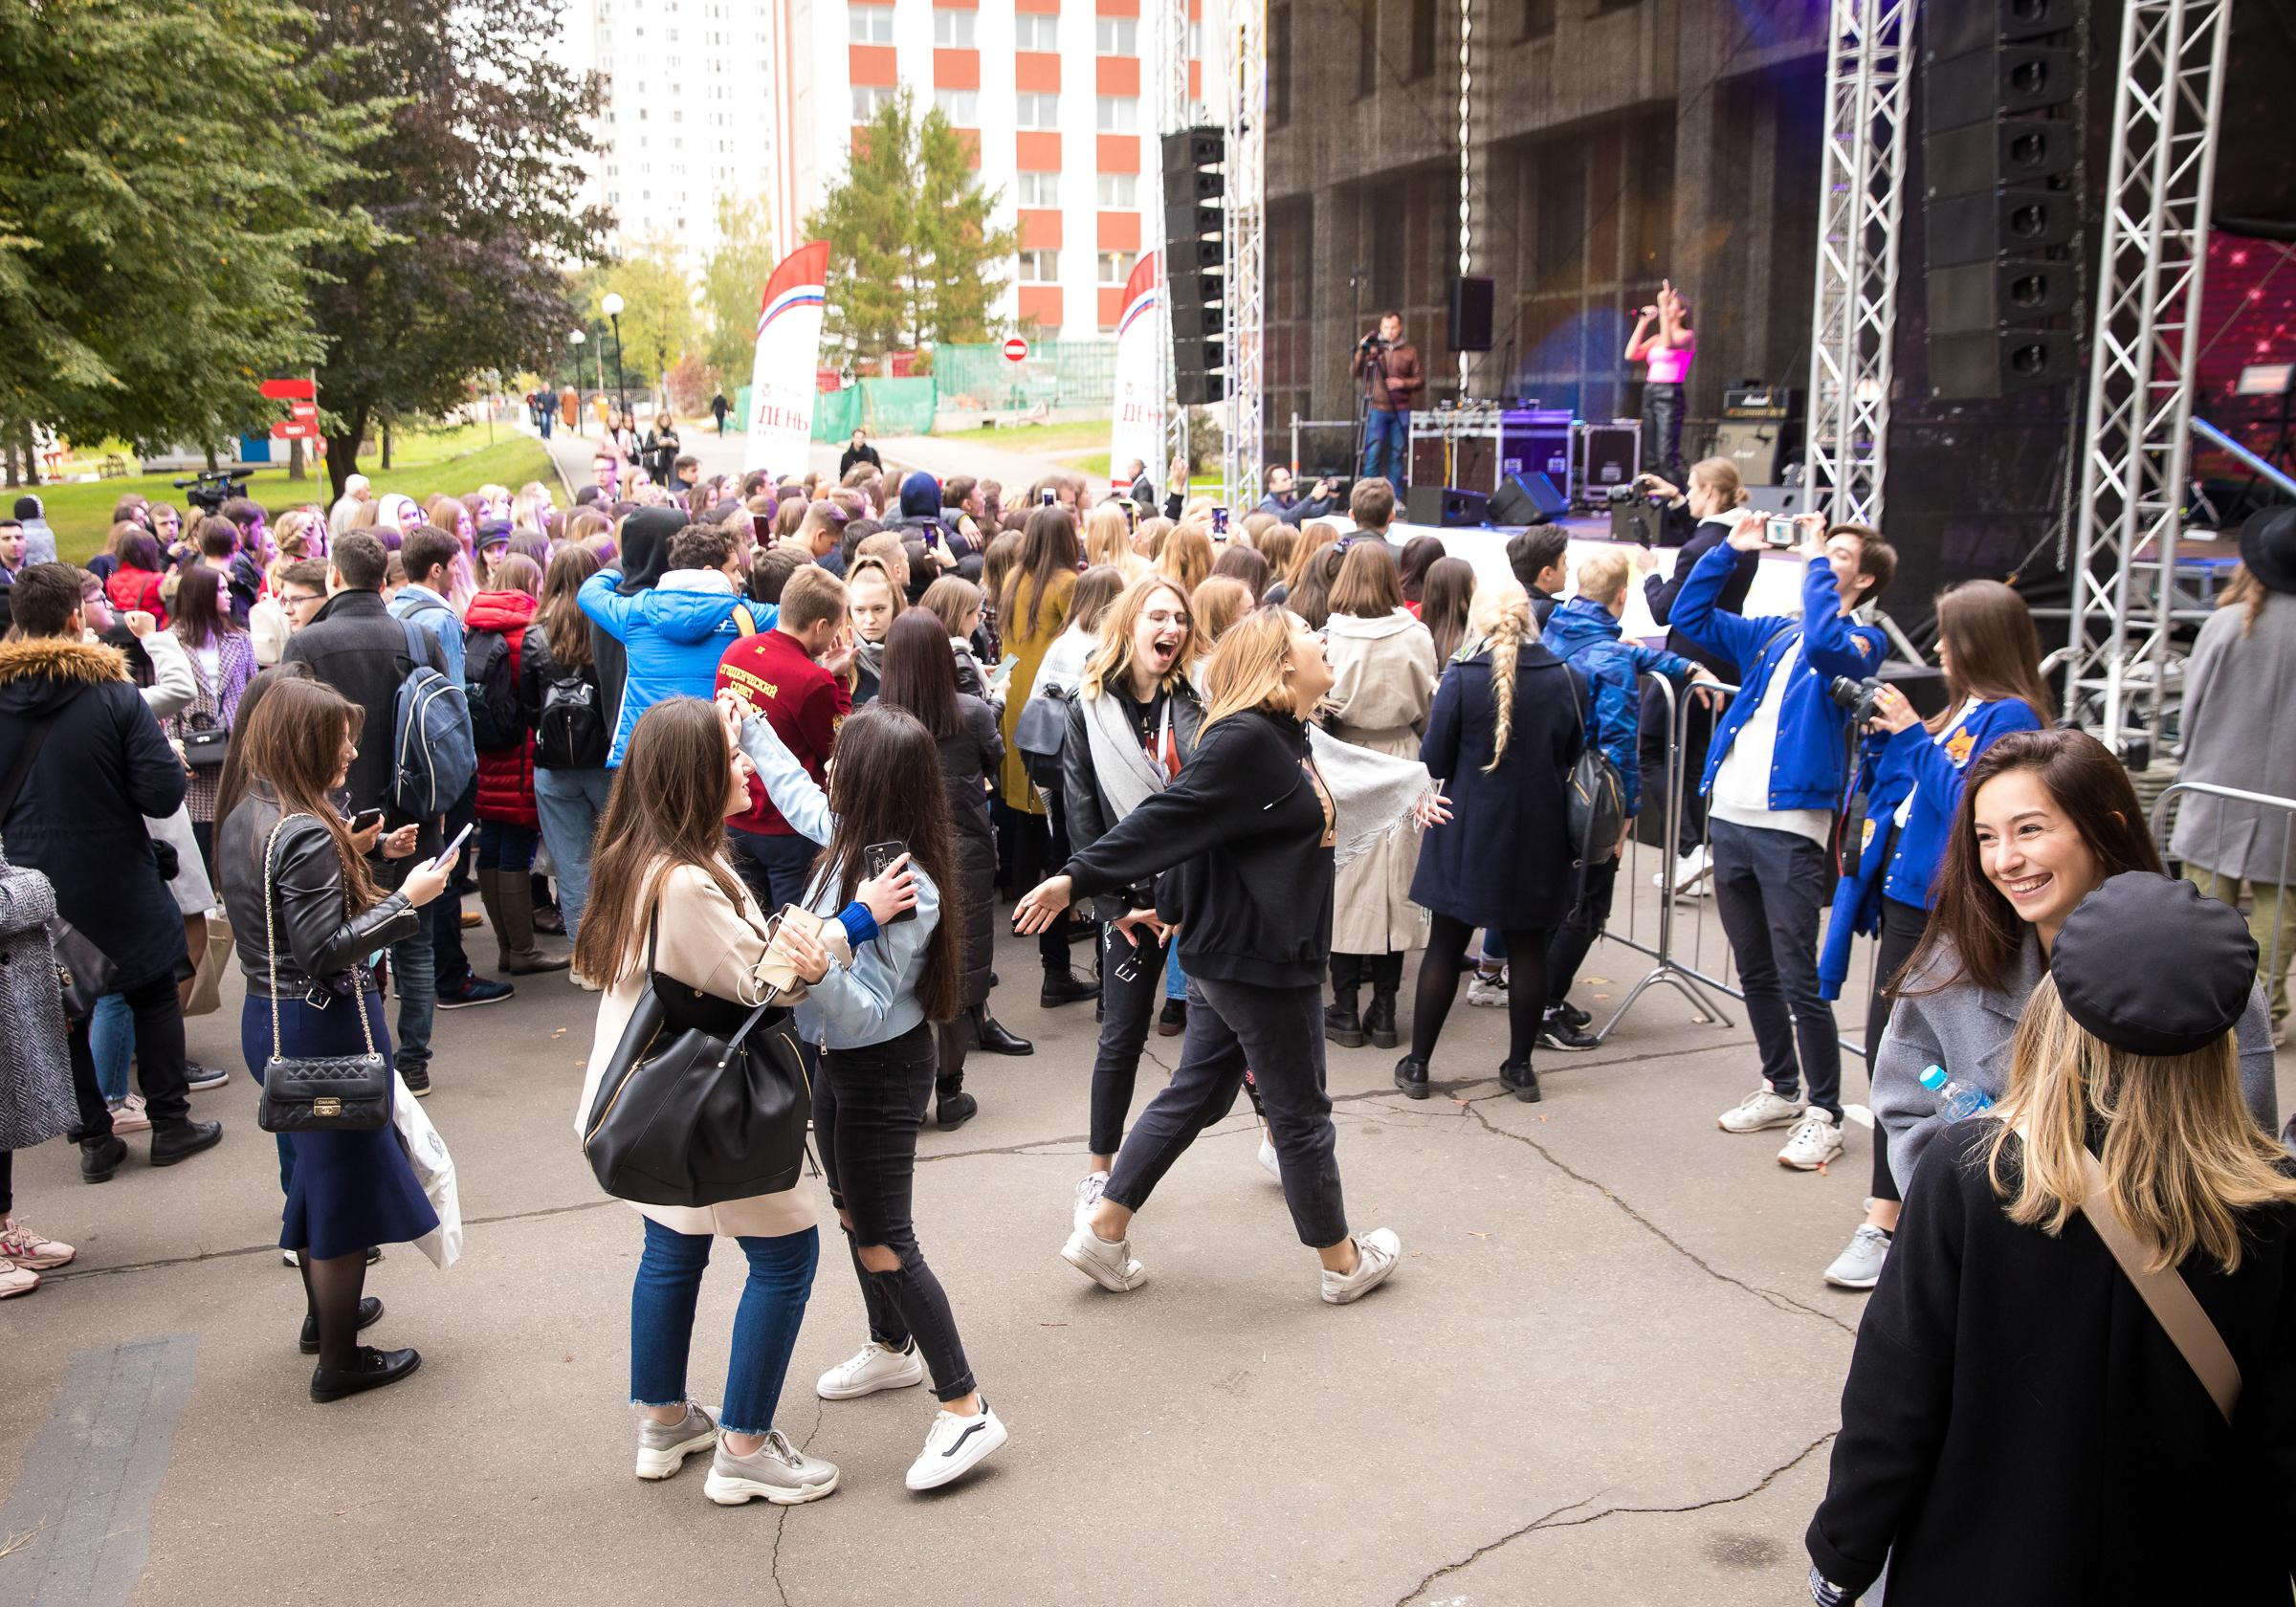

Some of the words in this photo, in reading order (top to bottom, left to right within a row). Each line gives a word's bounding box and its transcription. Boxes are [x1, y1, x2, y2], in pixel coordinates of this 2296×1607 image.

[758, 405, 808, 430] ДЕНЬ
[1122, 403, 1163, 429] ДЕН
[719, 663, 779, 699] СТУДЕНЧЕСКИЙ
[730, 680, 755, 700] СОВЕТ
